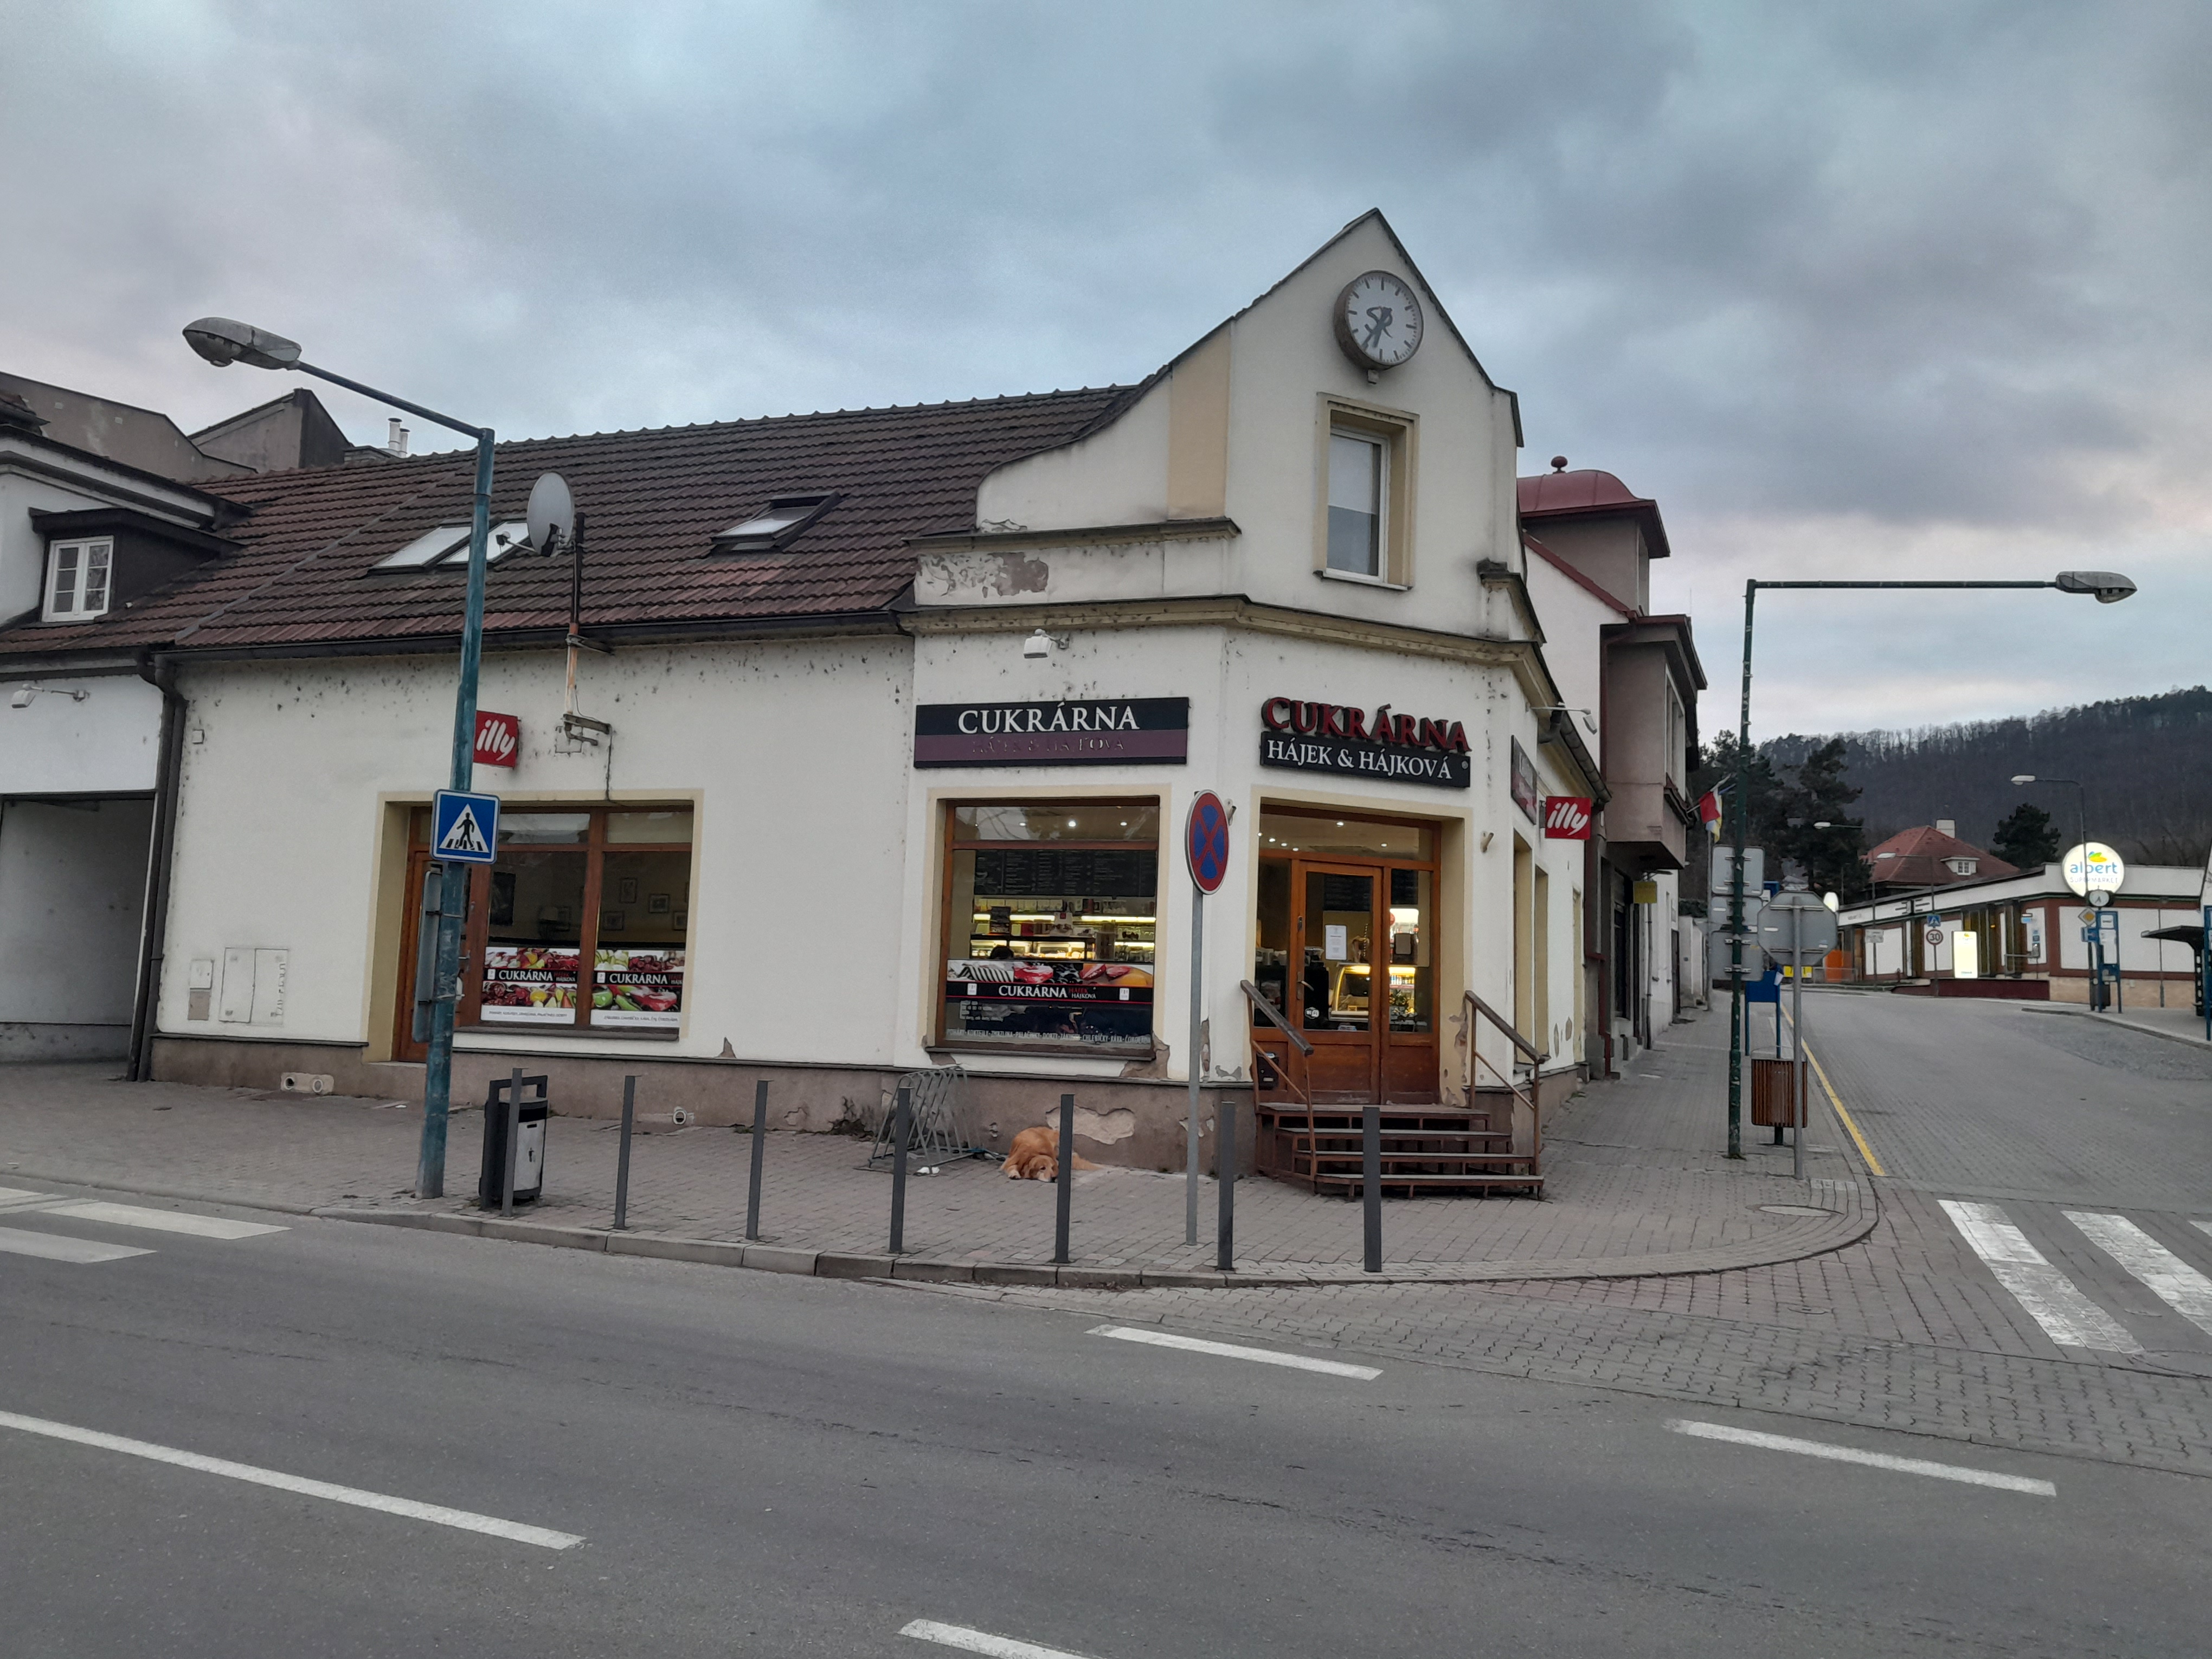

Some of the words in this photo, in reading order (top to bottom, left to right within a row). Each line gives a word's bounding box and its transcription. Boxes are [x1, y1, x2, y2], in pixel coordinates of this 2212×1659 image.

[958, 701, 1140, 734] CUKRÁRNA
[1261, 697, 1472, 752] CUKRÁRNA
[476, 719, 516, 761] illy
[1268, 737, 1332, 766] HÁJEK
[1338, 749, 1354, 768] &
[1359, 748, 1452, 779] HÁJKOVÁ
[1547, 802, 1589, 836] illy
[1929, 933, 1940, 942] 30
[499, 969, 553, 981] CUKRÁRNA
[609, 973, 668, 985] CUKRÁRNA
[999, 985, 1068, 998] CUKRÁRNA
